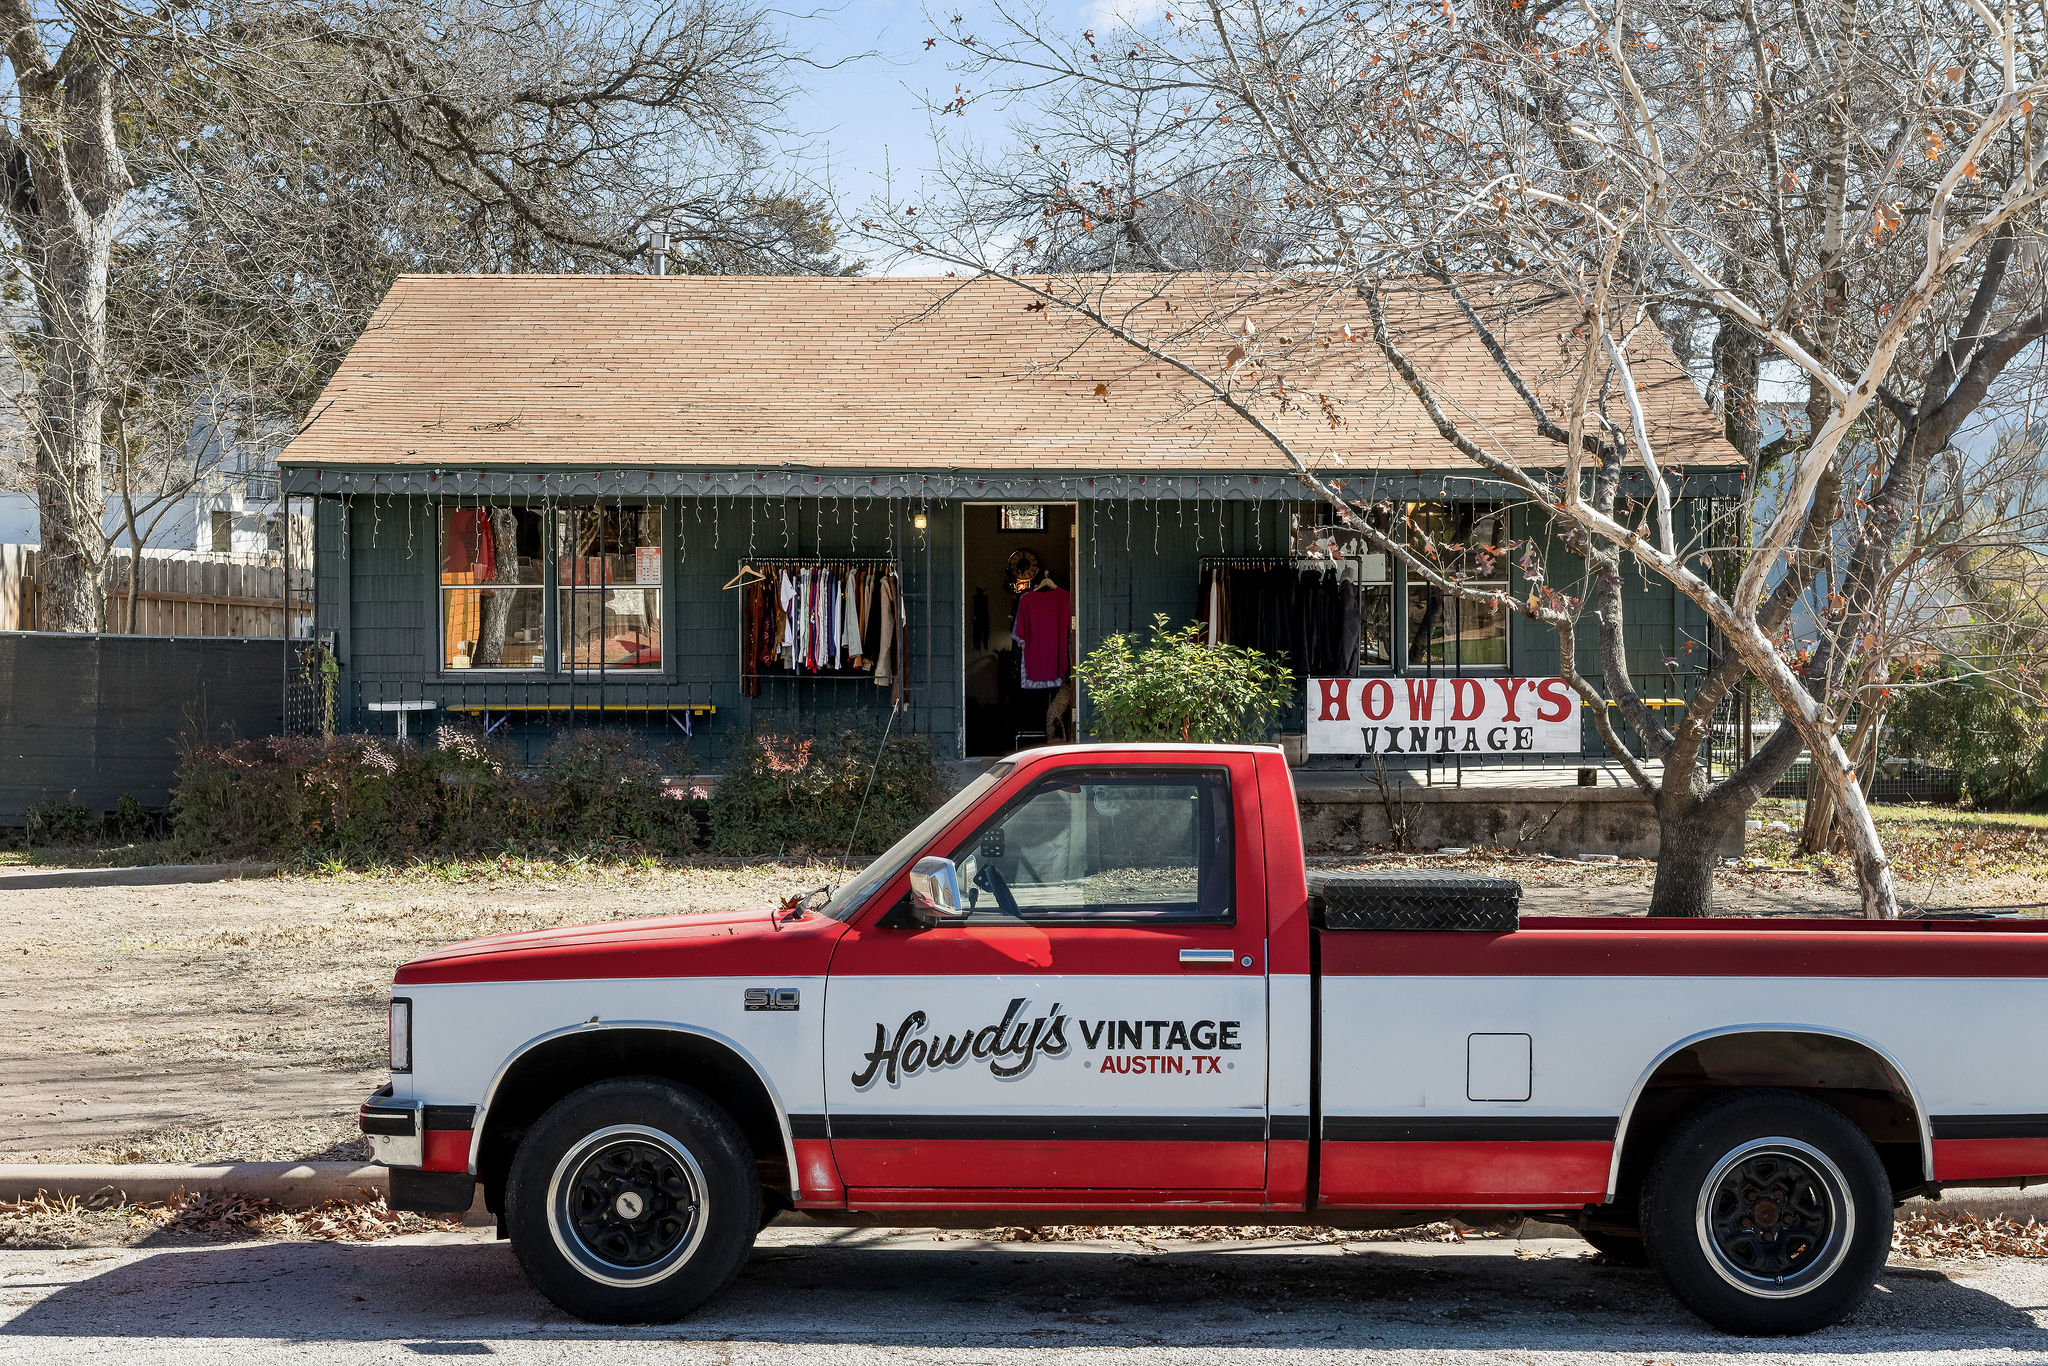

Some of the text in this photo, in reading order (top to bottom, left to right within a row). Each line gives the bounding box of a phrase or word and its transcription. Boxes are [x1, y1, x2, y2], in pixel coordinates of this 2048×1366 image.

[1317, 678, 1572, 722] HOWDY'S
[1360, 726, 1533, 753] VINTAGE
[851, 997, 1242, 1093] Howdy's VINTAGE
